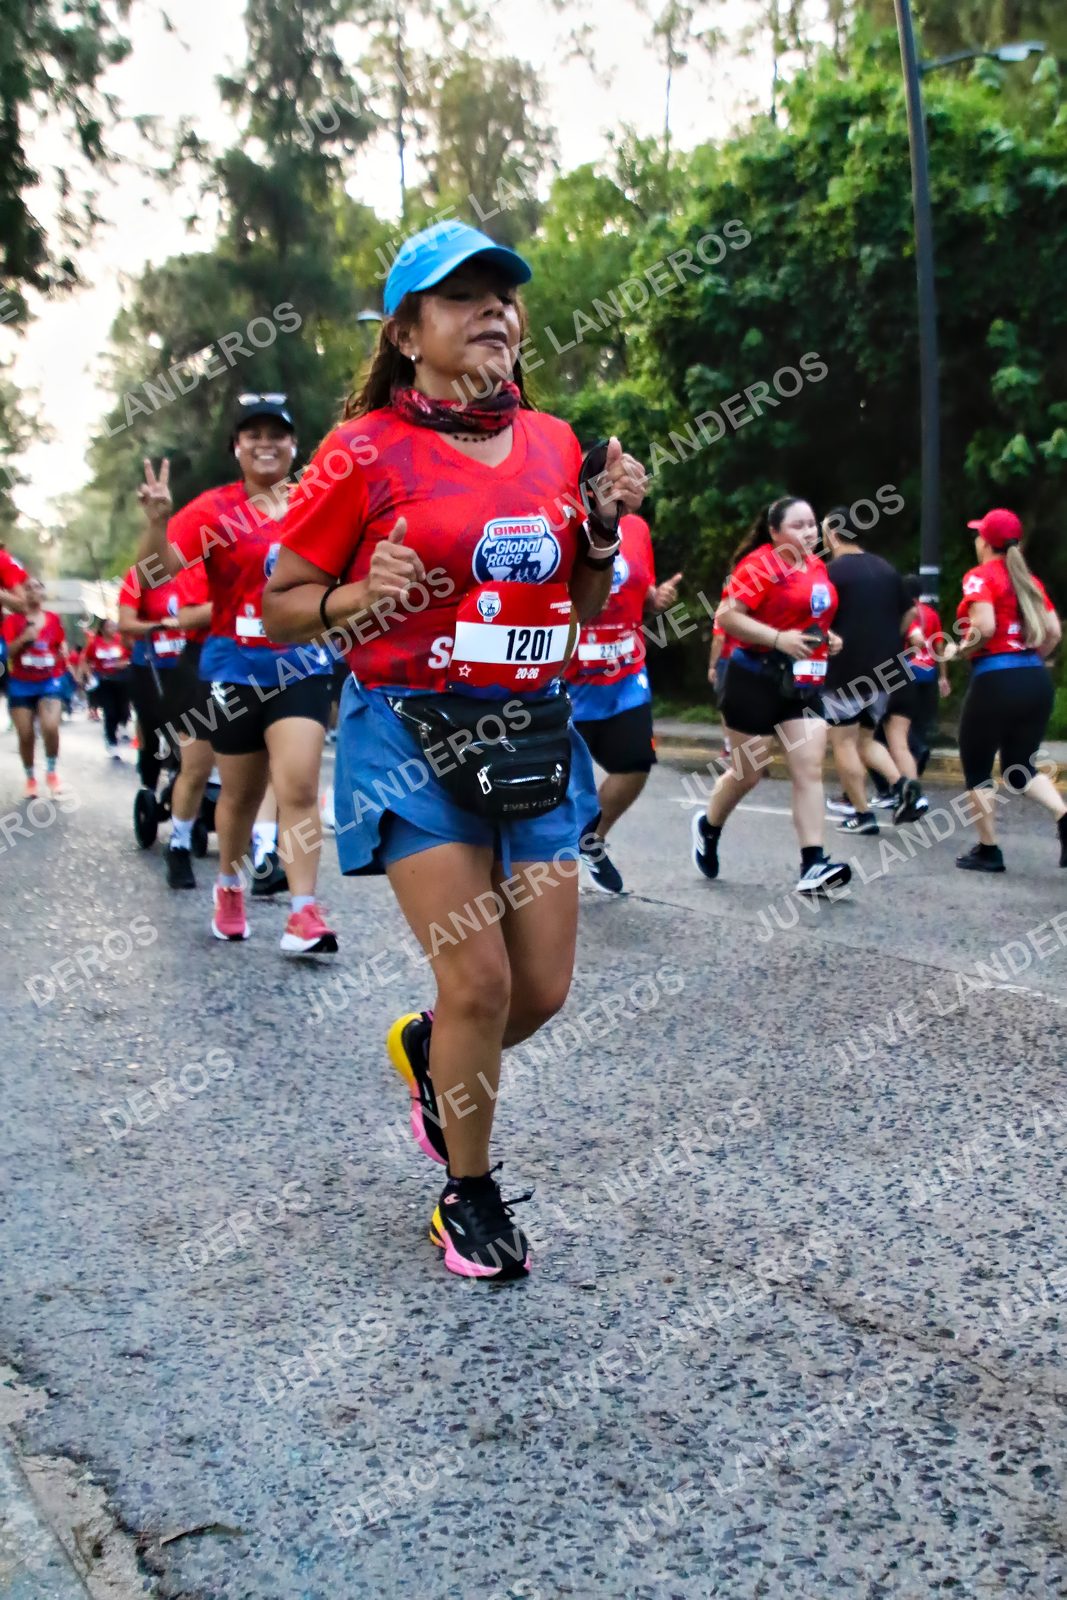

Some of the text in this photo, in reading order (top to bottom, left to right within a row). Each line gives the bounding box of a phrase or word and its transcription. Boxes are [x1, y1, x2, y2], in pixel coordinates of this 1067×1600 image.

[493, 524, 541, 536] BIMBO
[495, 538, 542, 554] Global
[486, 553, 523, 567] Race
[506, 629, 553, 661] 1201
